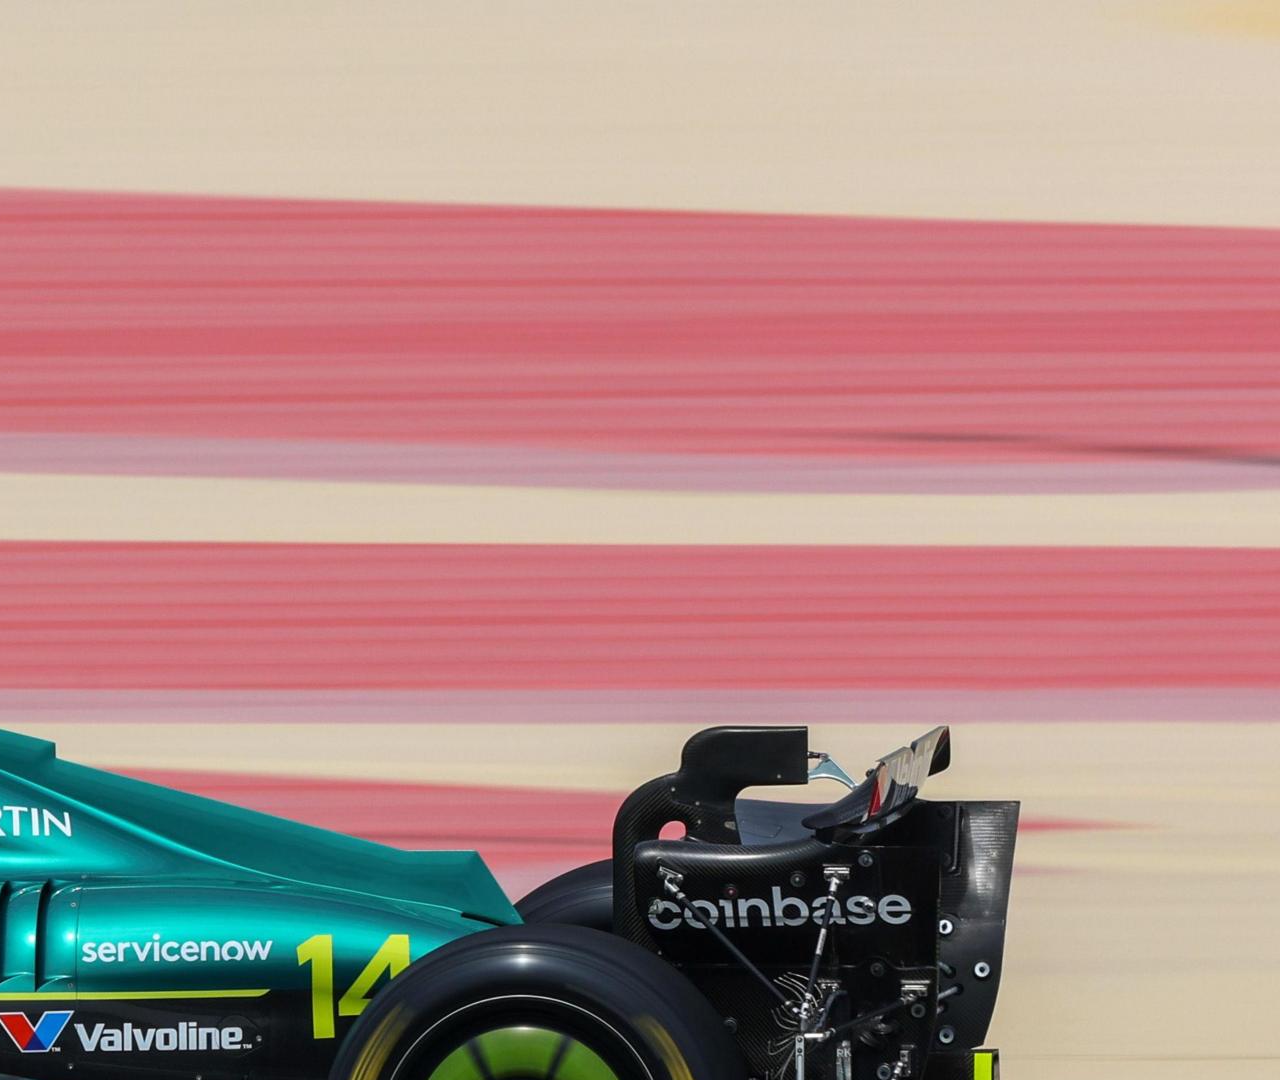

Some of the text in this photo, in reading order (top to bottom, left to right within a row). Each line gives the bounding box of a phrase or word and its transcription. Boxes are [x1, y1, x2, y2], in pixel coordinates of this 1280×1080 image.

[648, 886, 912, 930] coinbase
[82, 933, 272, 963] servicenow
[296, 934, 410, 1039] 14
[74, 1022, 243, 1052] Valvoline
